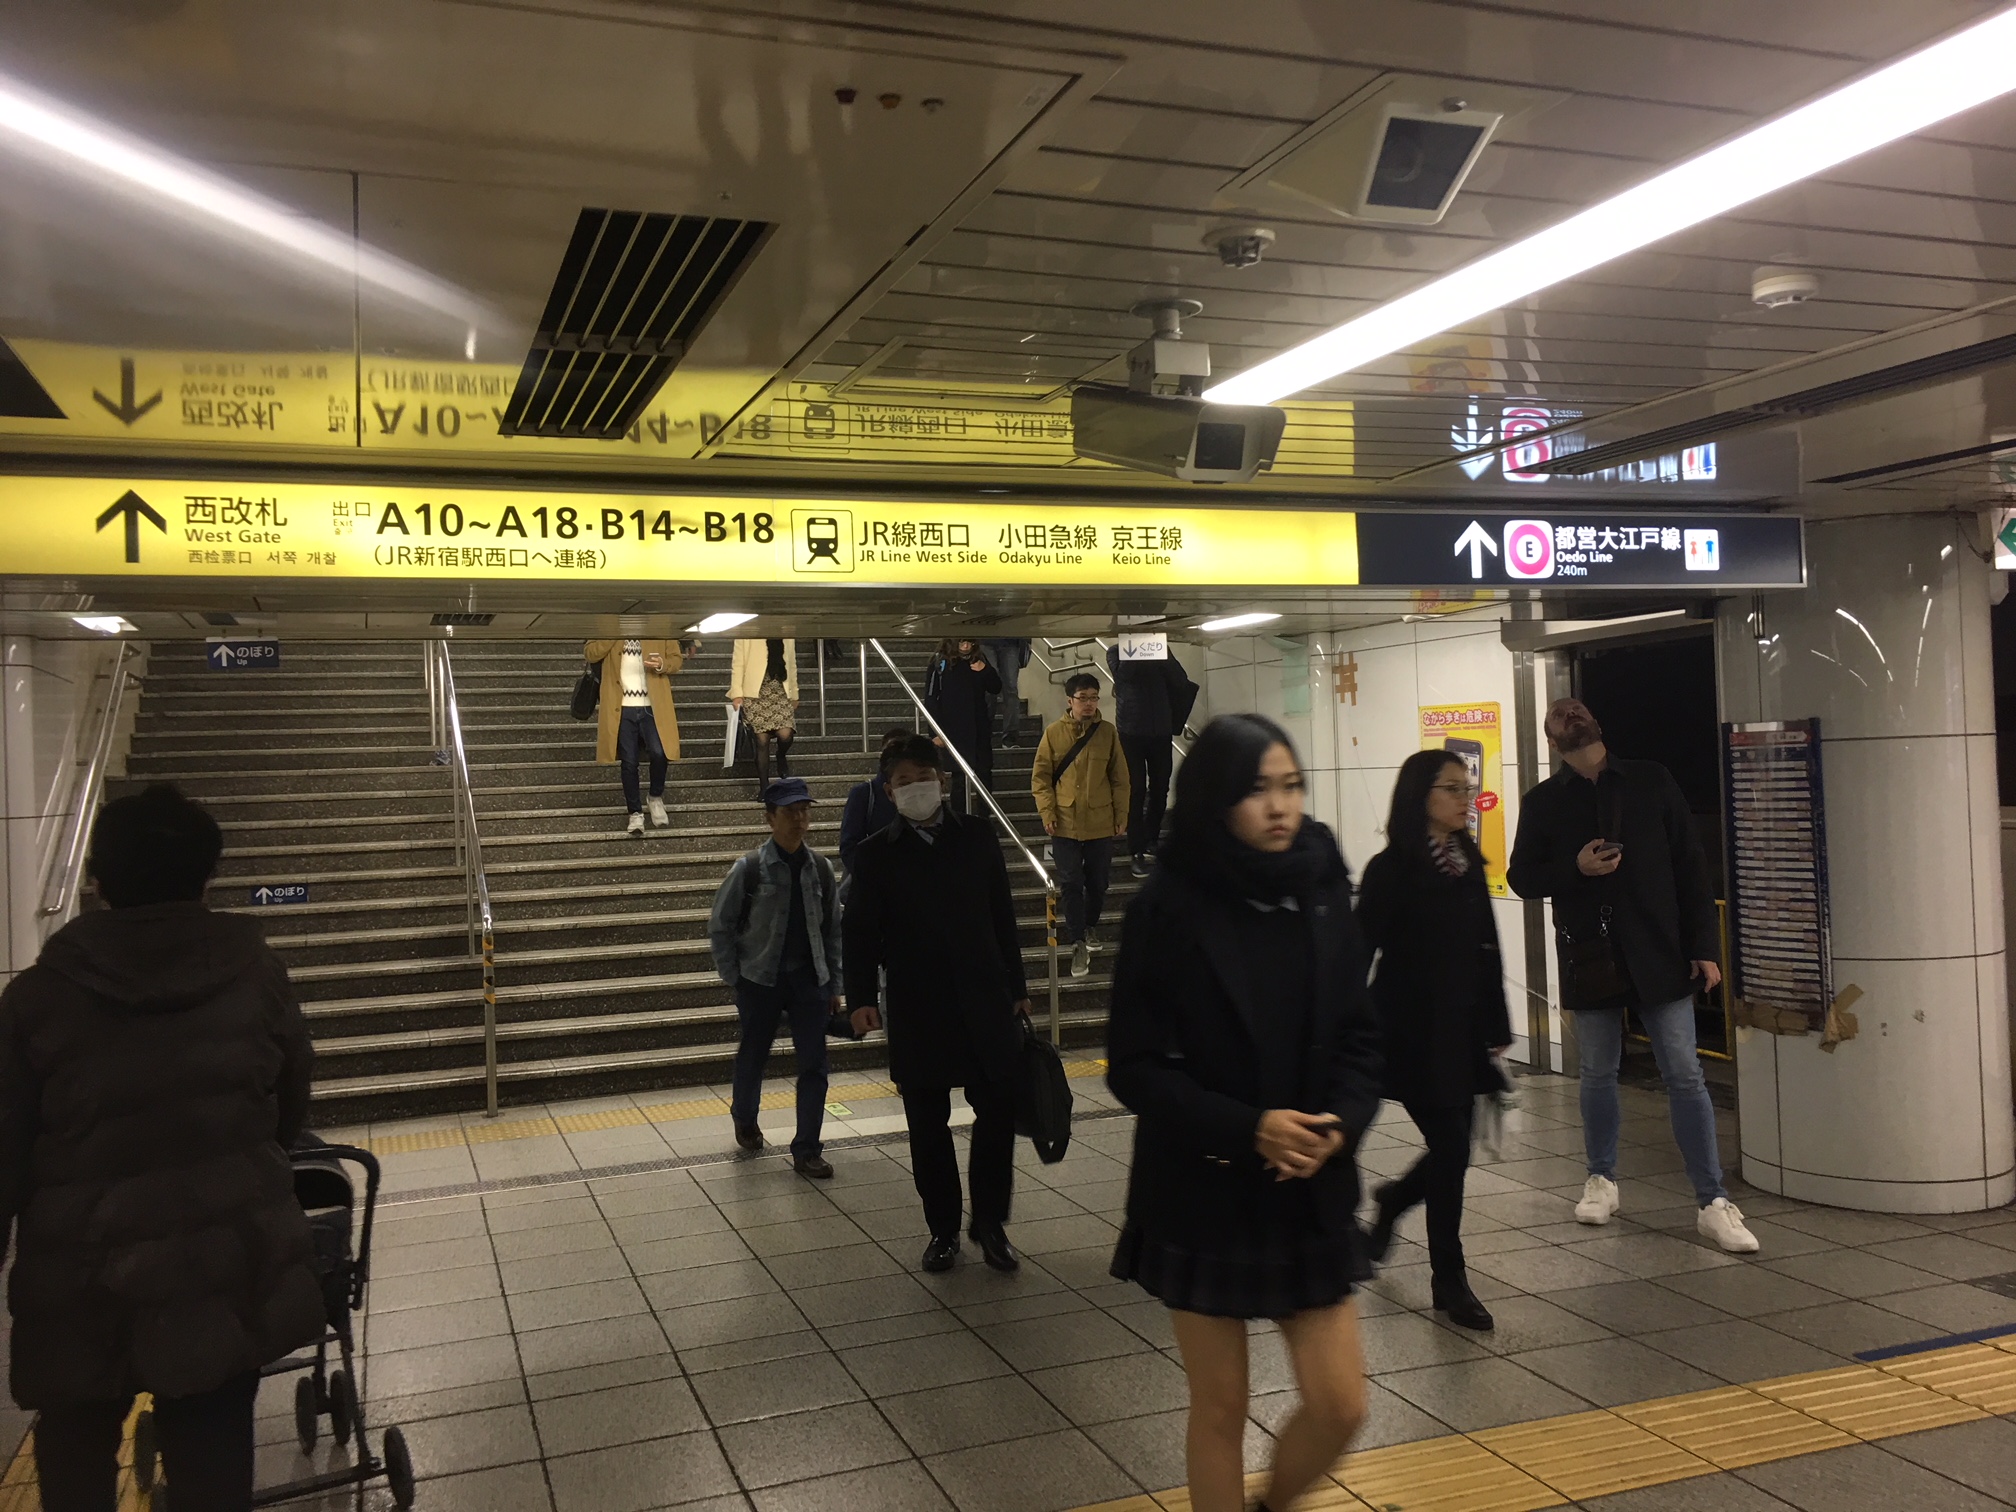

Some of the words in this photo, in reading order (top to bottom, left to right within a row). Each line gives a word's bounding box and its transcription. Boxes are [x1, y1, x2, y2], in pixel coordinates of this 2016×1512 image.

[184, 496, 288, 527] 西改札
[332, 500, 371, 517] 出口
[333, 518, 353, 530] Exit
[184, 528, 233, 543] West
[238, 529, 282, 544] Gate
[858, 521, 971, 548] JR線西口
[998, 523, 1098, 550] 小田急線
[1111, 525, 1184, 551] 京王線
[1554, 526, 1681, 551] 都営大江戸線
[188, 549, 252, 566] 西检票口
[860, 549, 875, 563] JR
[881, 549, 911, 563] Line
[915, 550, 953, 564] West
[957, 550, 988, 564] Side
[1525, 541, 1534, 558] E
[1556, 550, 1587, 563] Oedo
[1590, 550, 1614, 563] Line
[266, 550, 298, 565] 서쪽
[306, 551, 337, 566] 개찰
[999, 551, 1051, 567] Odakyu
[1055, 551, 1083, 565] Line
[1112, 552, 1141, 565] Keio
[1145, 552, 1171, 566] Line
[1557, 564, 1588, 576] 240m
[236, 646, 275, 658] のぼり
[1139, 642, 1163, 652] くだり
[273, 886, 305, 897] のぼり
